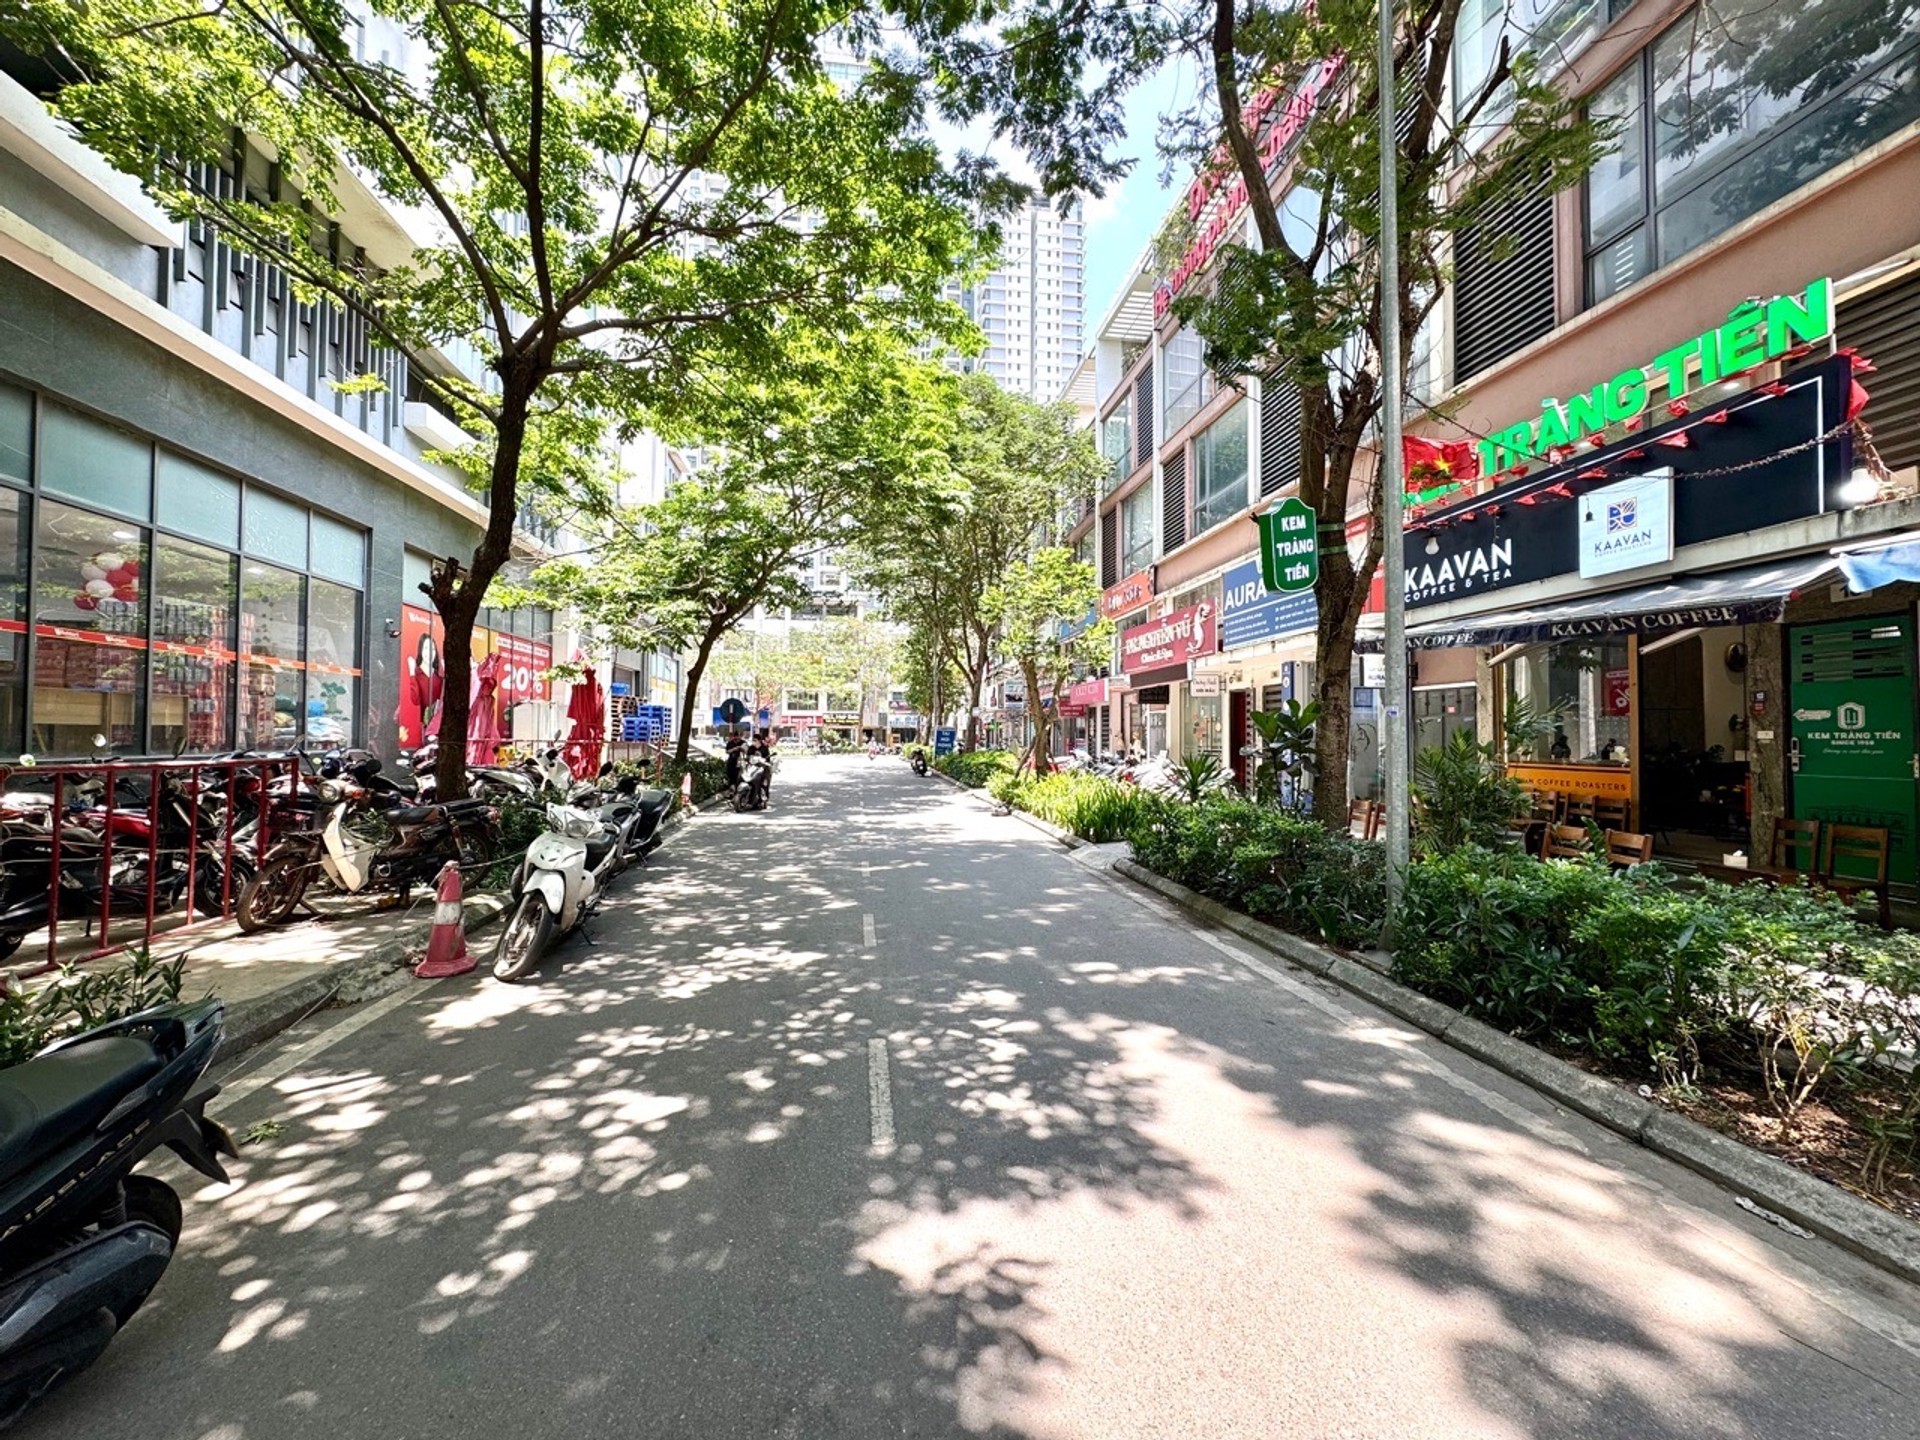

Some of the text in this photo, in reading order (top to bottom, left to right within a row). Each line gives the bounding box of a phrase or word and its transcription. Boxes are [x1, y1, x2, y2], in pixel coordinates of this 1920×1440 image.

[1477, 368, 1649, 476] TRÀNG
[1281, 514, 1306, 532] KEM
[1276, 537, 1314, 557] TRÀNG
[1594, 528, 1652, 554] KAAVAN
[1403, 538, 1512, 593] KAAVAN
[1224, 577, 1268, 612] AURA
[1403, 568, 1512, 603] COFFEE & TEA
[1551, 606, 1739, 637] KAAVAN COFFEE
[1423, 632, 1475, 648] COFFEE
[1537, 778, 1571, 788] COFFEE
[1575, 781, 1627, 792] ROASTERS
